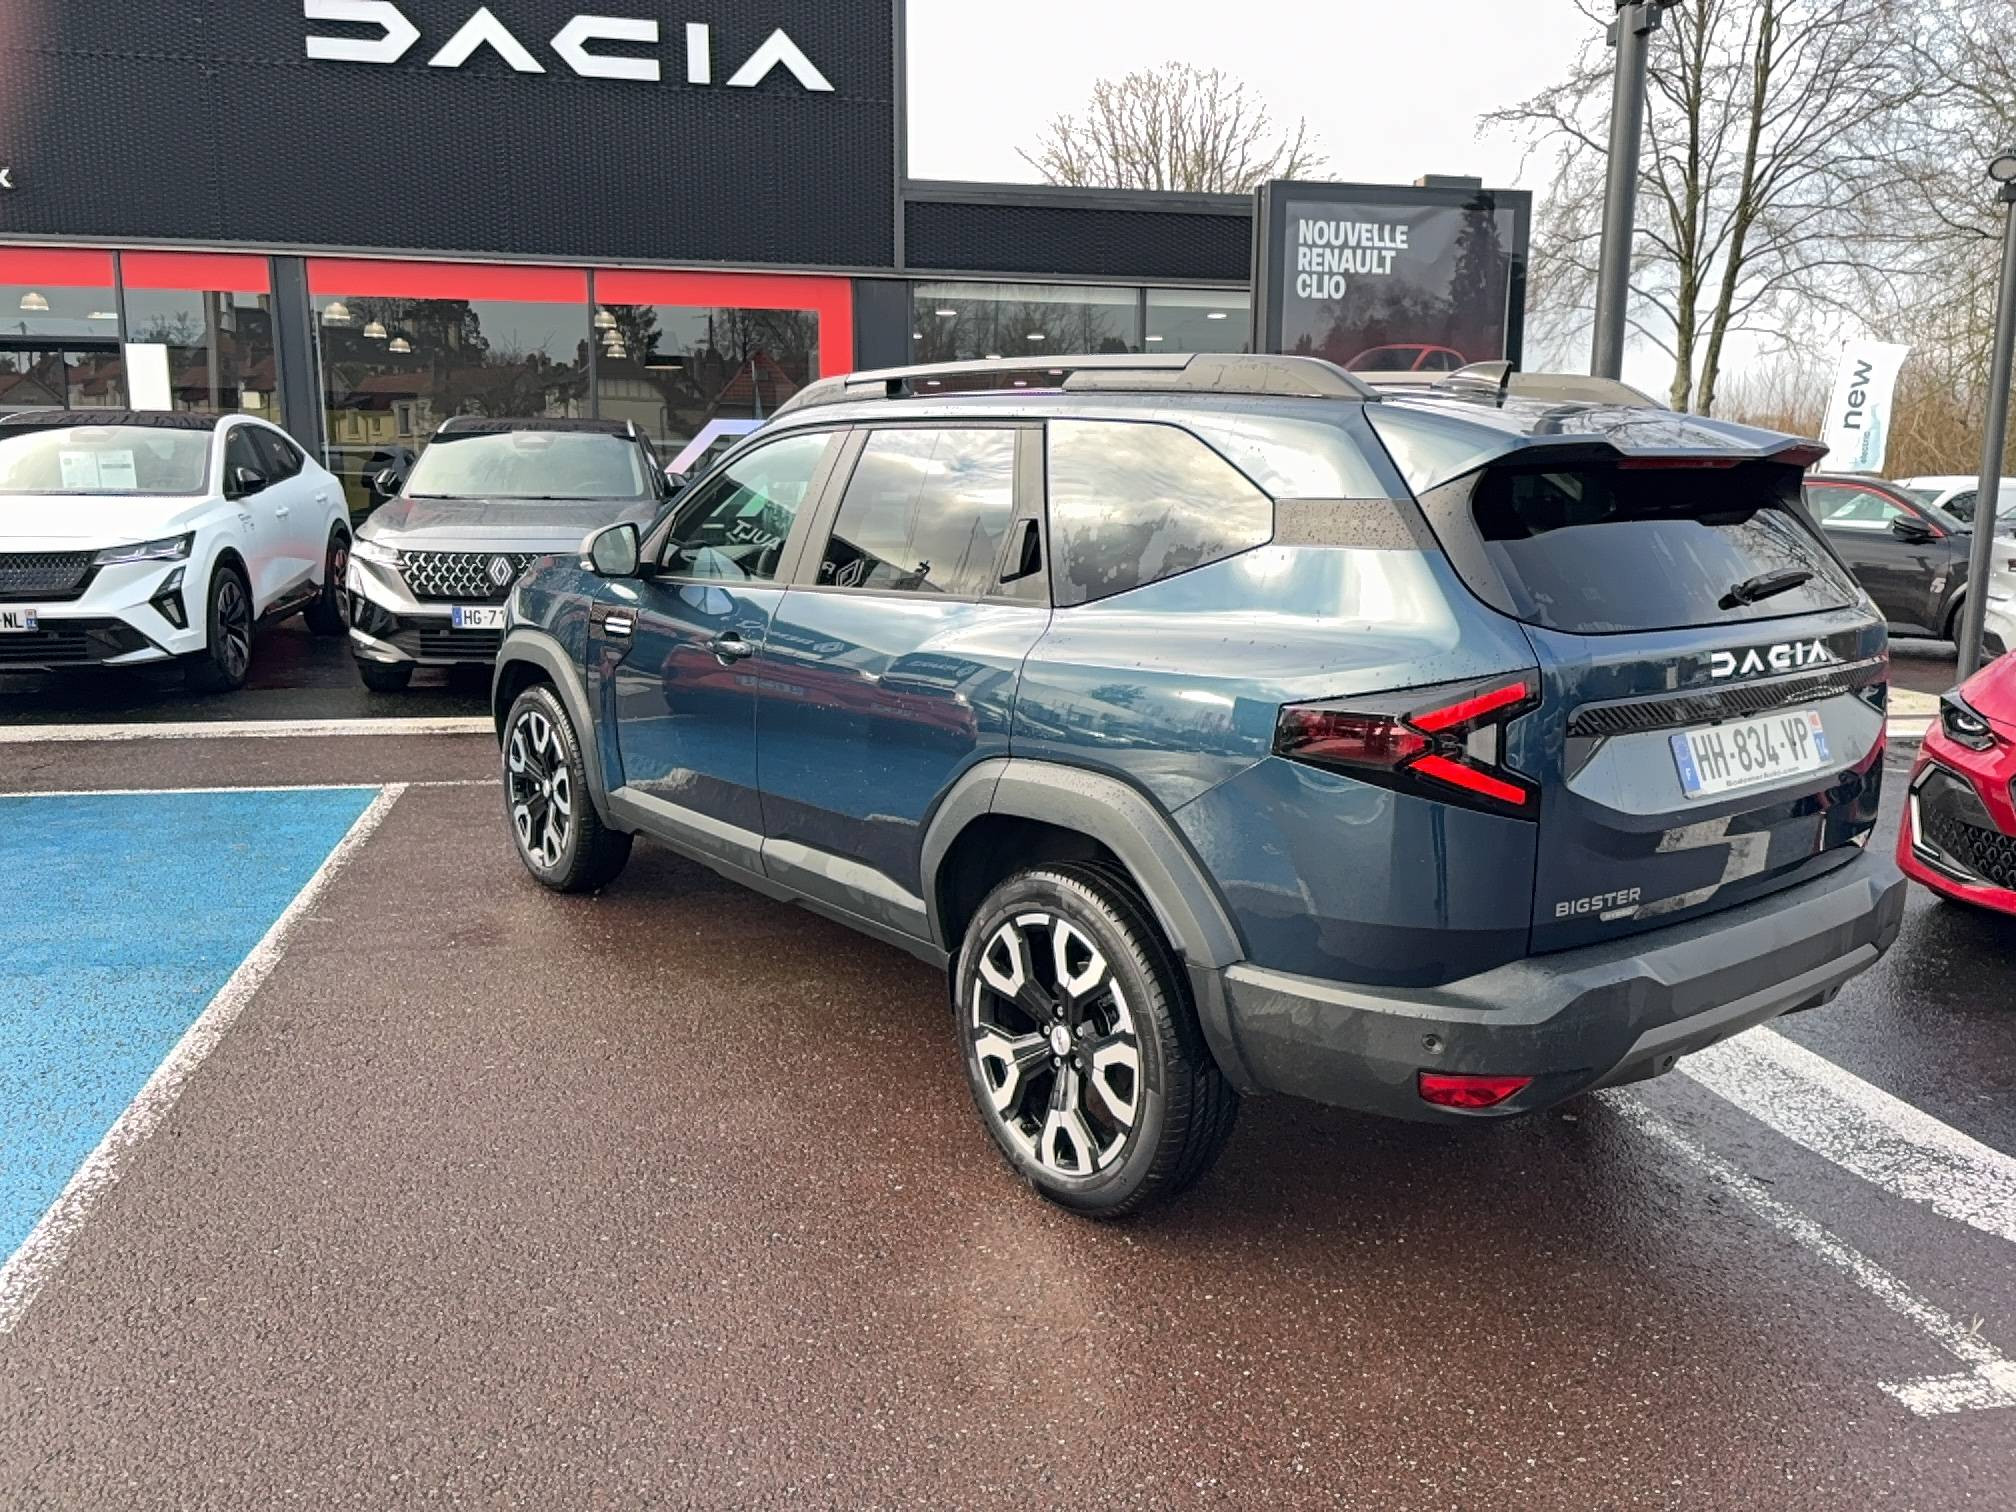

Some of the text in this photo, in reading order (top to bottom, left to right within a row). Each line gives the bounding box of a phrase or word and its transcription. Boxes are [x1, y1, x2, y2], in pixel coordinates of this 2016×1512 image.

[303, 0, 836, 92] DACIA
[1298, 219, 1409, 249] NOUVELLE
[1297, 246, 1397, 275] RENAULT
[1295, 273, 1347, 300] CLIO
[1843, 359, 1873, 430] new
[1710, 640, 1828, 678] DACIA
[1691, 717, 1809, 782] HH-834-VP
[1555, 887, 1641, 918] BIGSTER
